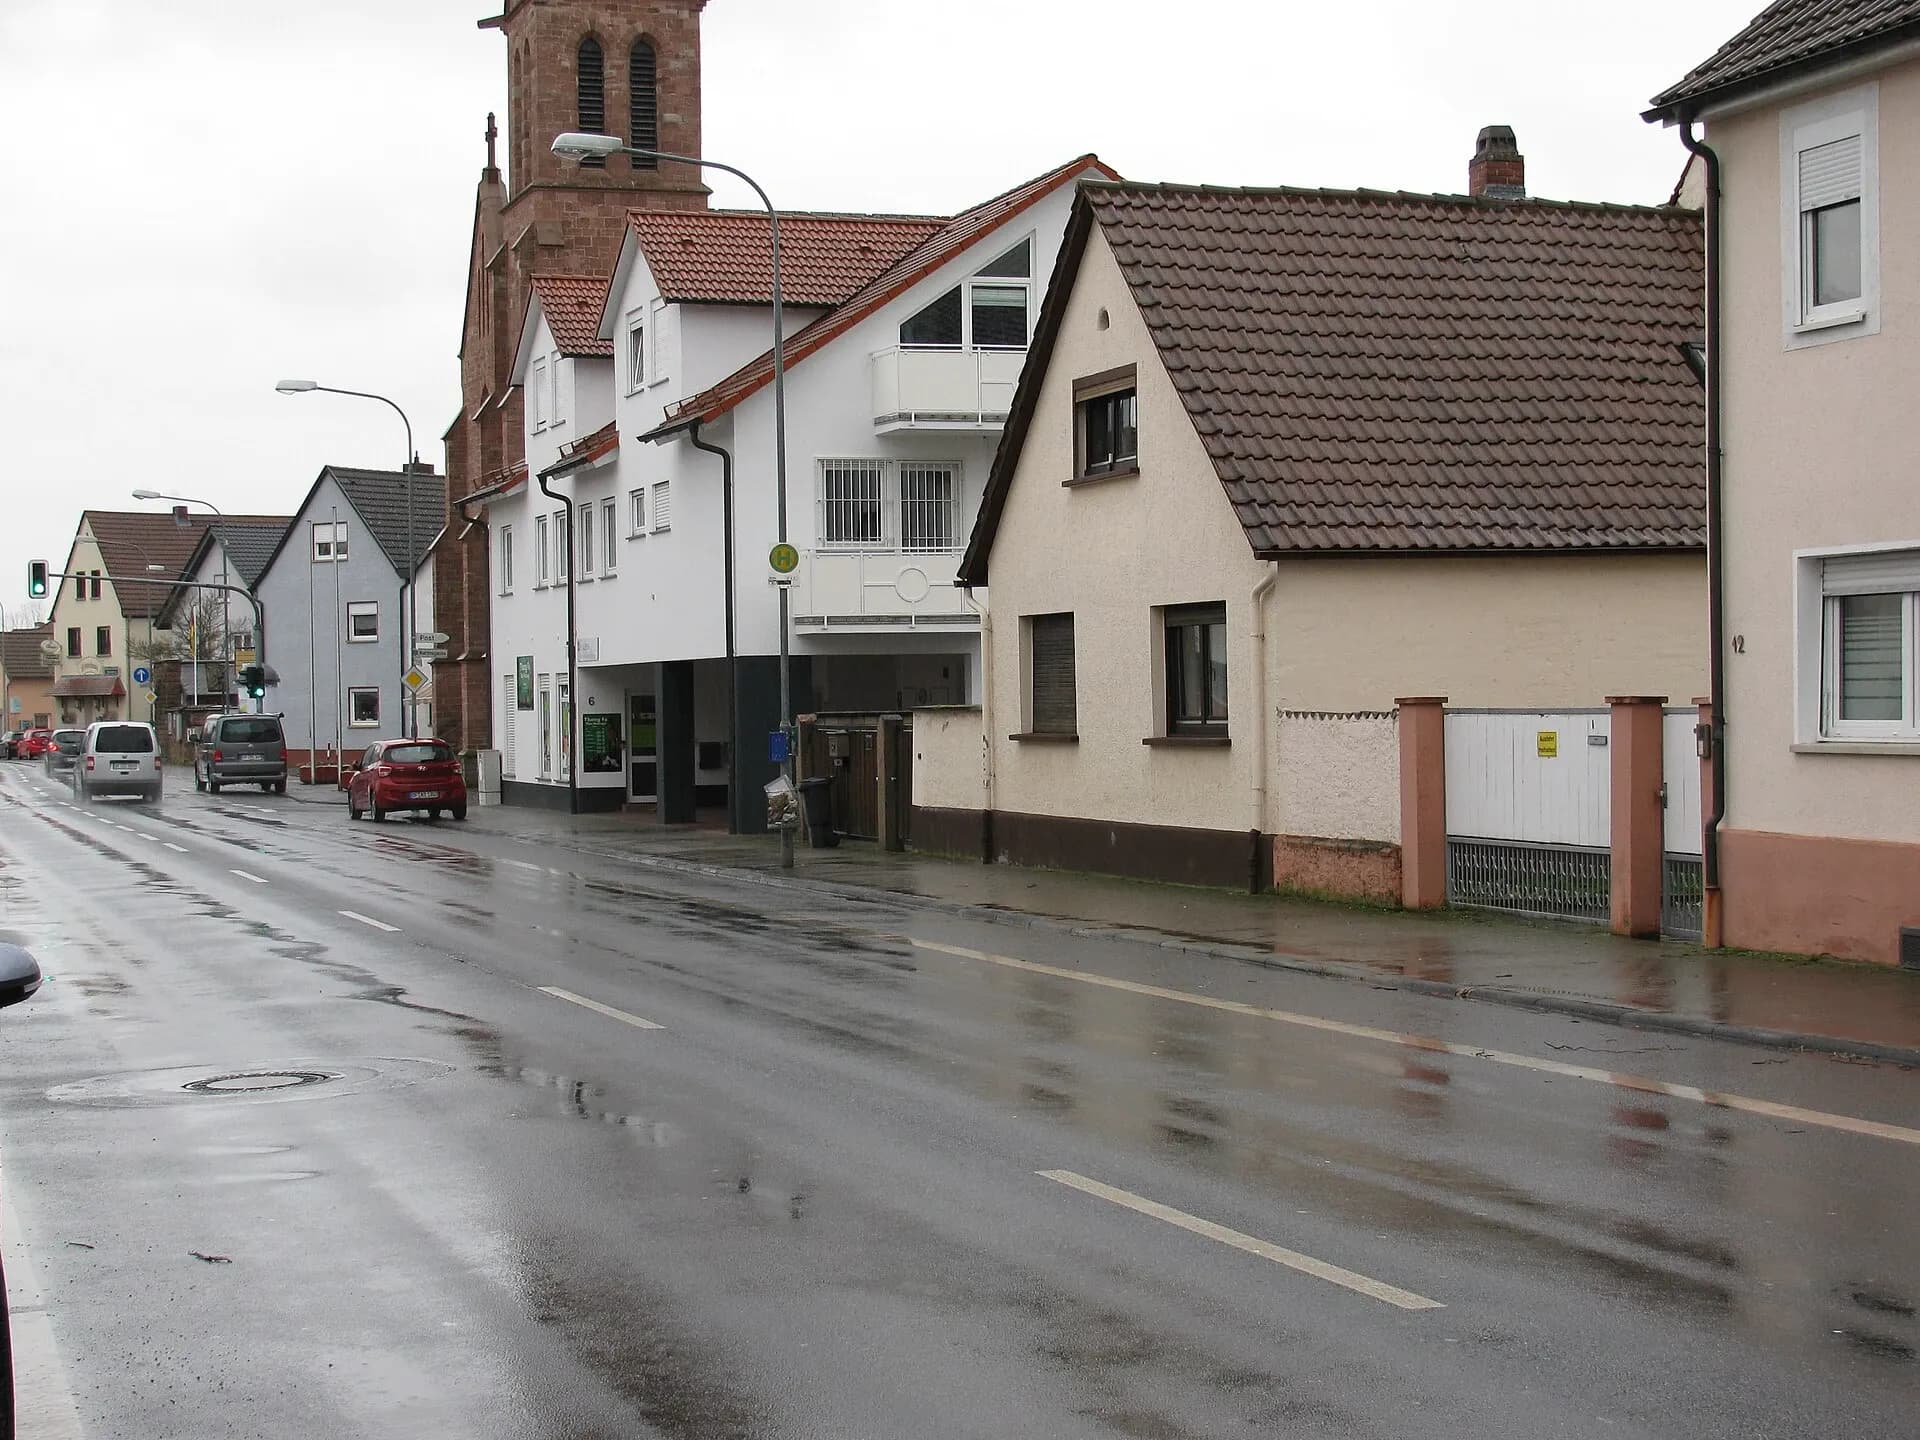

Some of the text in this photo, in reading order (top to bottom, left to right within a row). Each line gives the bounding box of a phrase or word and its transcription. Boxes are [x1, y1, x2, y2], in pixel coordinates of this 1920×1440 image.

[776, 550, 791, 567] H
[1731, 634, 1746, 654] 12
[588, 696, 595, 706] 6
